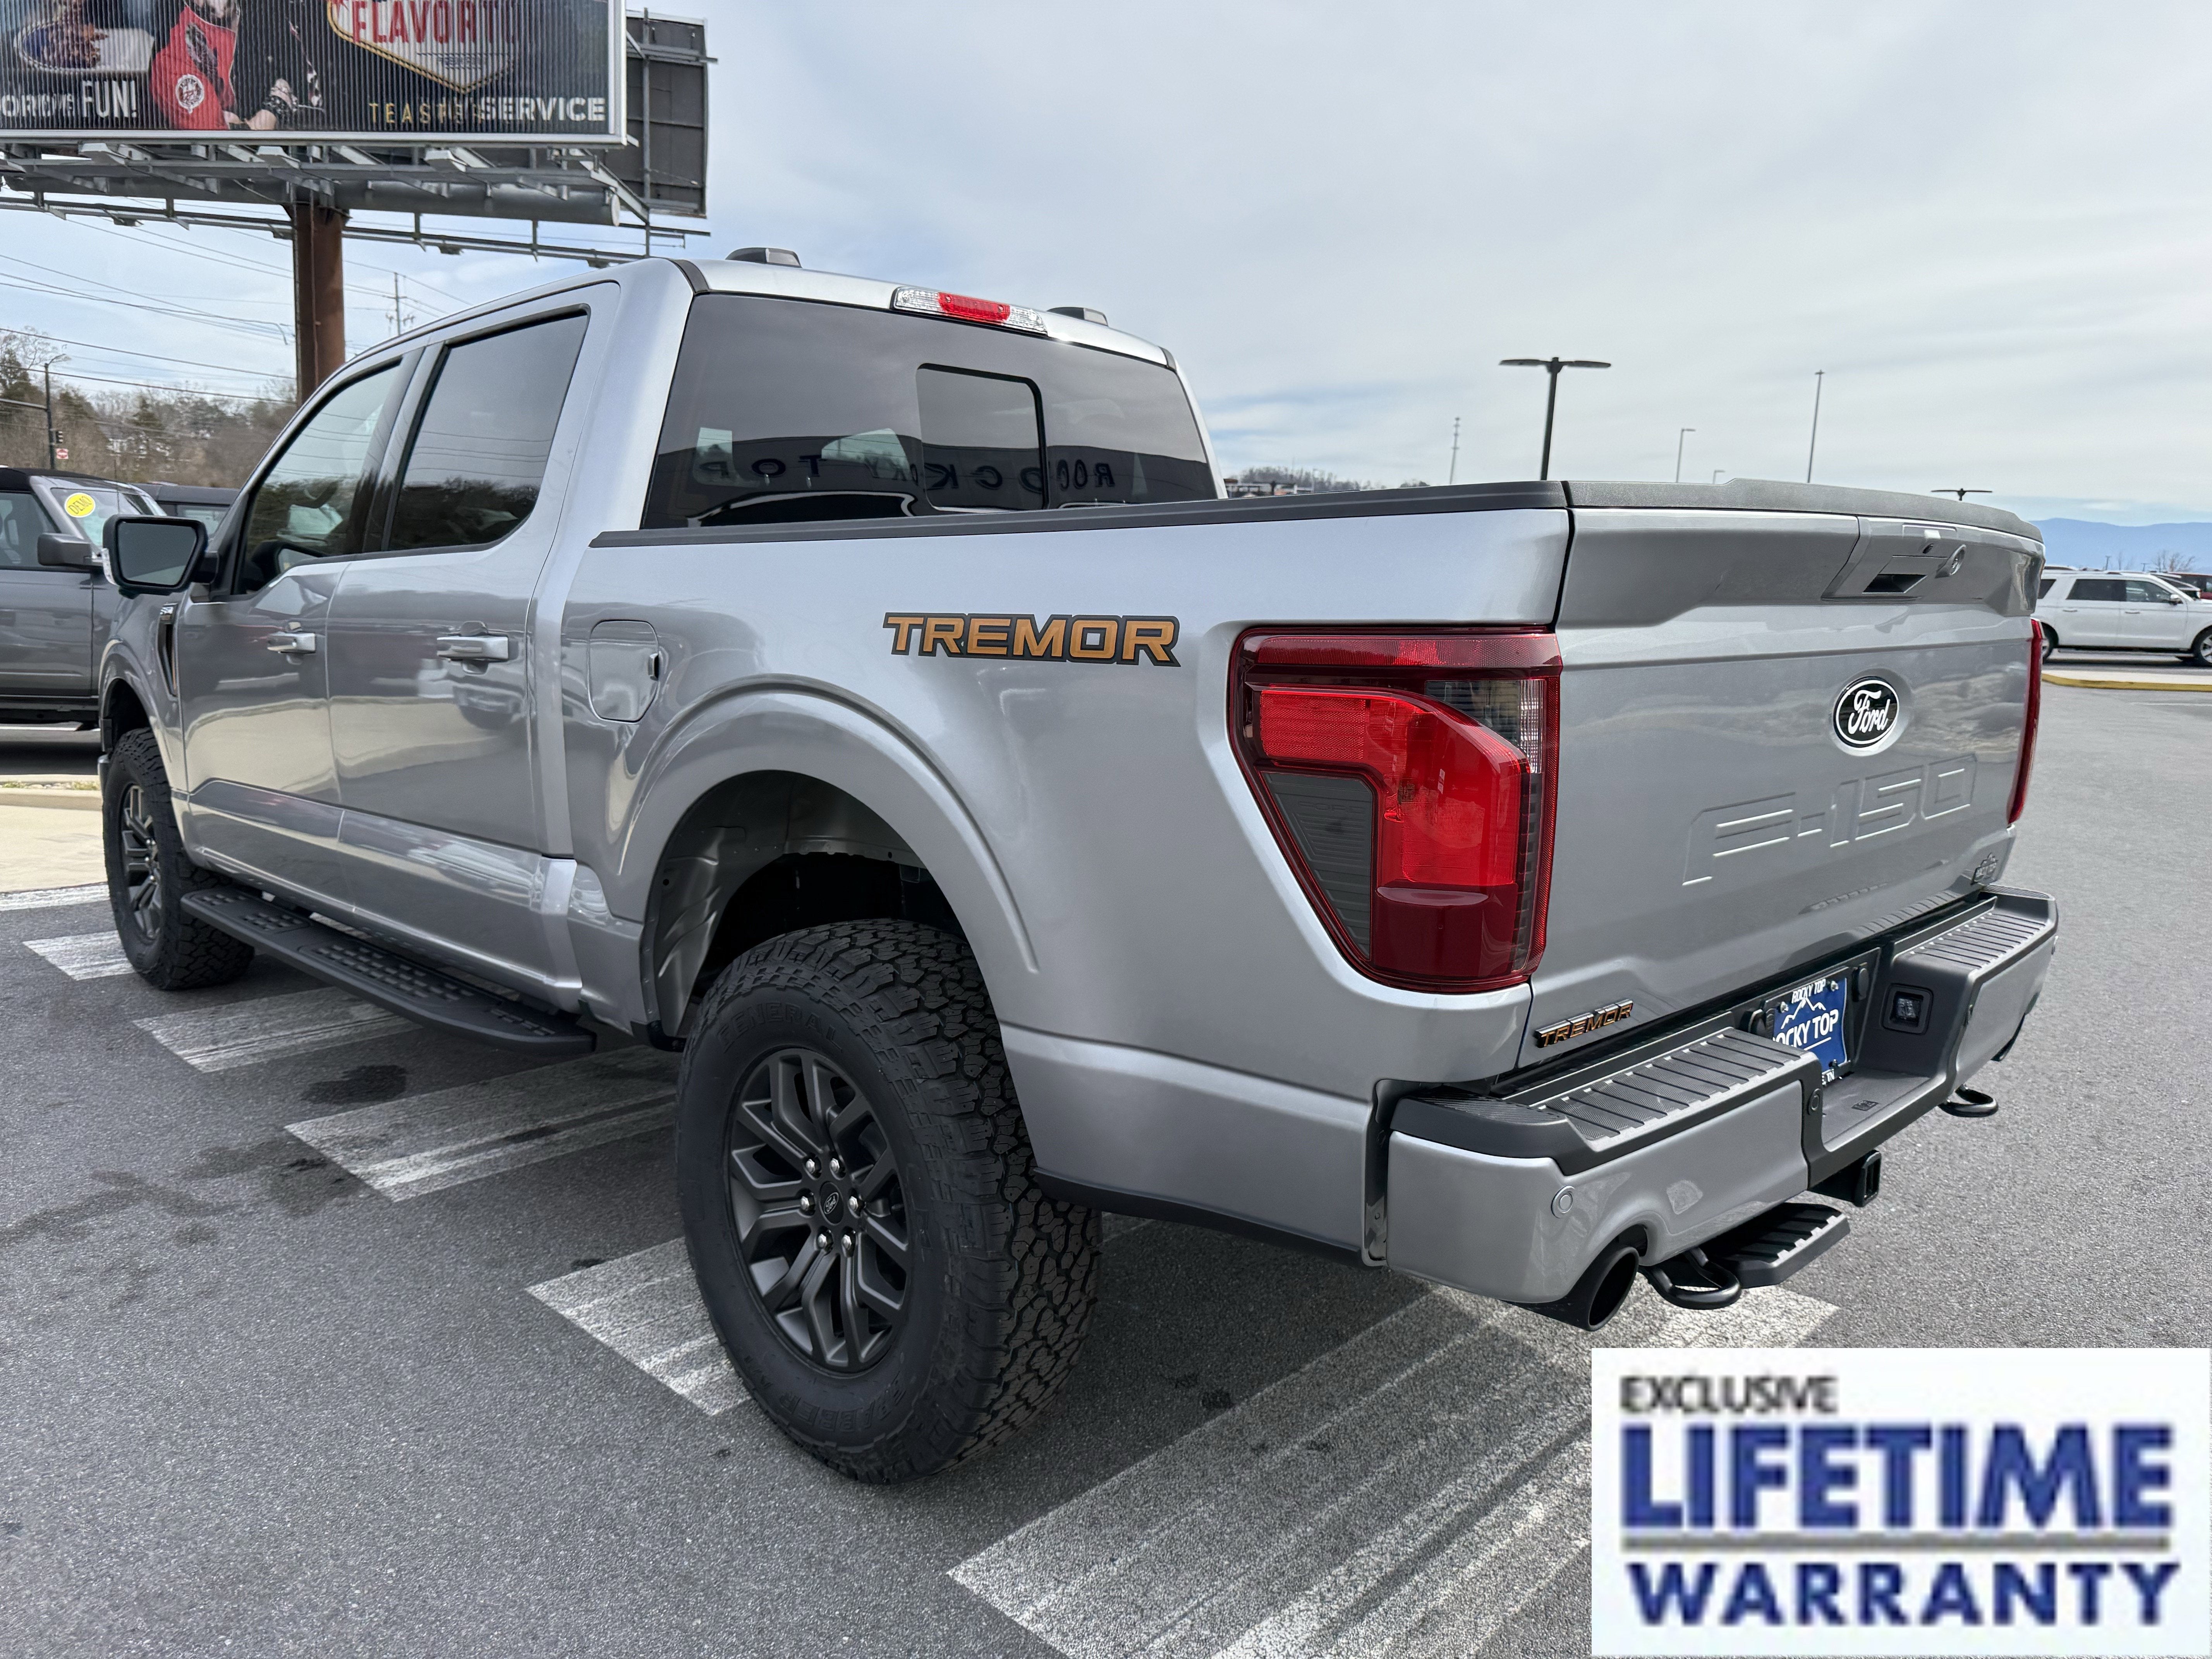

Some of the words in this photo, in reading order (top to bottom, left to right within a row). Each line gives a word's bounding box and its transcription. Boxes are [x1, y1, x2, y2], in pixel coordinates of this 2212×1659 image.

[82, 80, 137, 117] FUN!
[479, 97, 605, 121] SERVICE
[68, 496, 92, 515] DEMO
[883, 613, 1180, 666] TREMOR
[1848, 690, 1891, 734] Ford
[1682, 754, 1977, 886] F-150
[1791, 984, 1814, 1004] ROCKY
[1814, 979, 1826, 994] TOP
[718, 1002, 843, 1053] GENERAL
[1536, 999, 1633, 1048] TREMOR
[1772, 1020, 1811, 1048] OCKY
[1813, 1009, 1839, 1039] TOP
